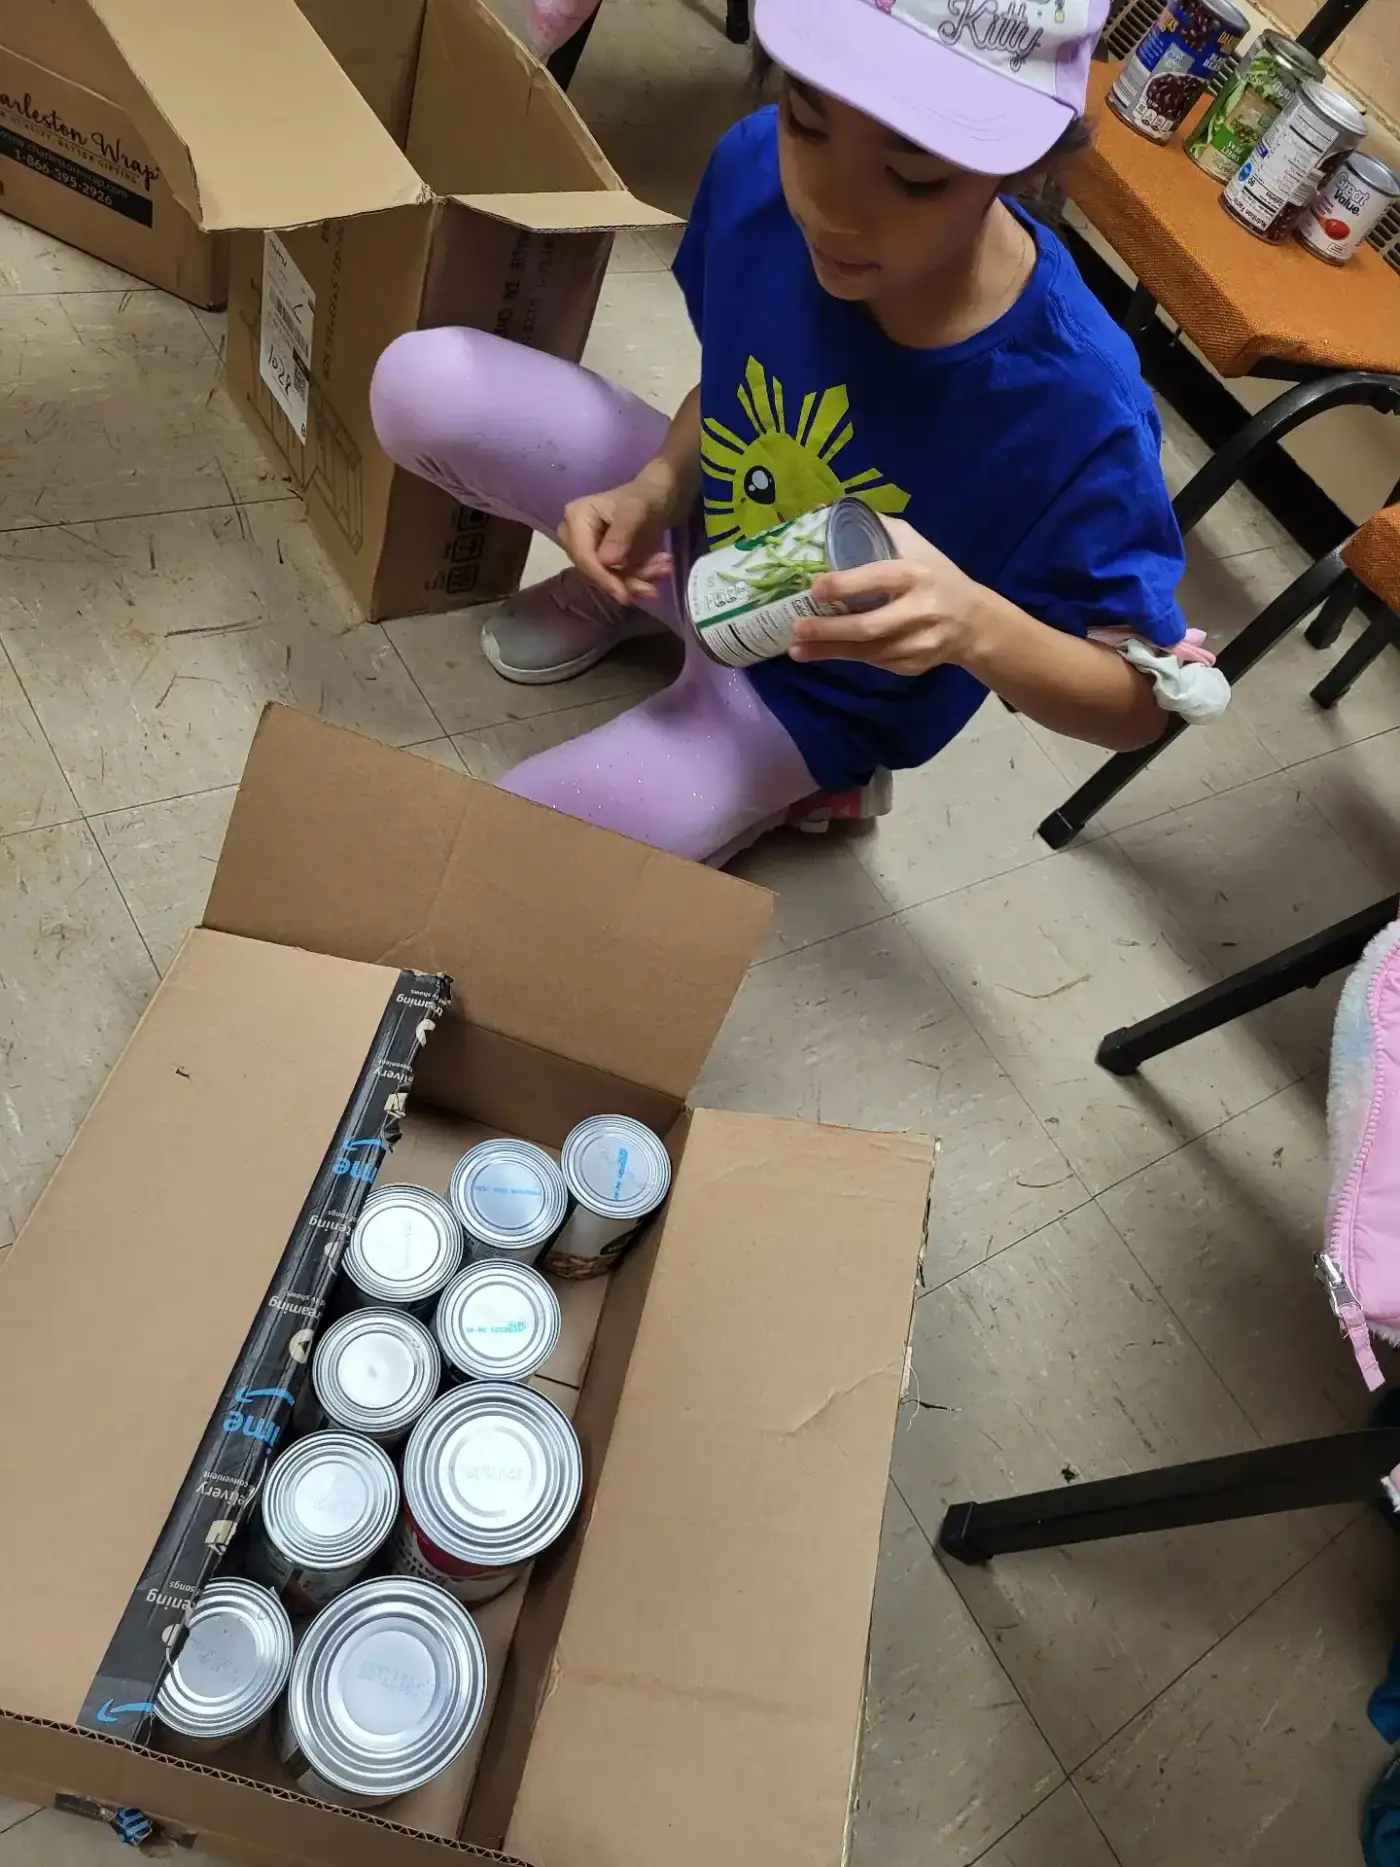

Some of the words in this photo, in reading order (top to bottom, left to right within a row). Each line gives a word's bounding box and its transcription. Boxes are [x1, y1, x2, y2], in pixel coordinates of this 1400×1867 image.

[938, 0, 1044, 72] Kitty
[0, 92, 88, 146] arleston
[91, 132, 159, 191] Wrap
[1336, 171, 1371, 206] Great
[1245, 208, 1267, 229] Nutrition
[396, 993, 444, 1017] treaming
[332, 1156, 378, 1183] me
[308, 1214, 353, 1237] tening
[267, 1295, 324, 1319] reaming
[223, 1410, 281, 1455] ime
[195, 1480, 248, 1507] elivery
[169, 1580, 197, 1593] songs
[145, 1588, 194, 1611] ening
